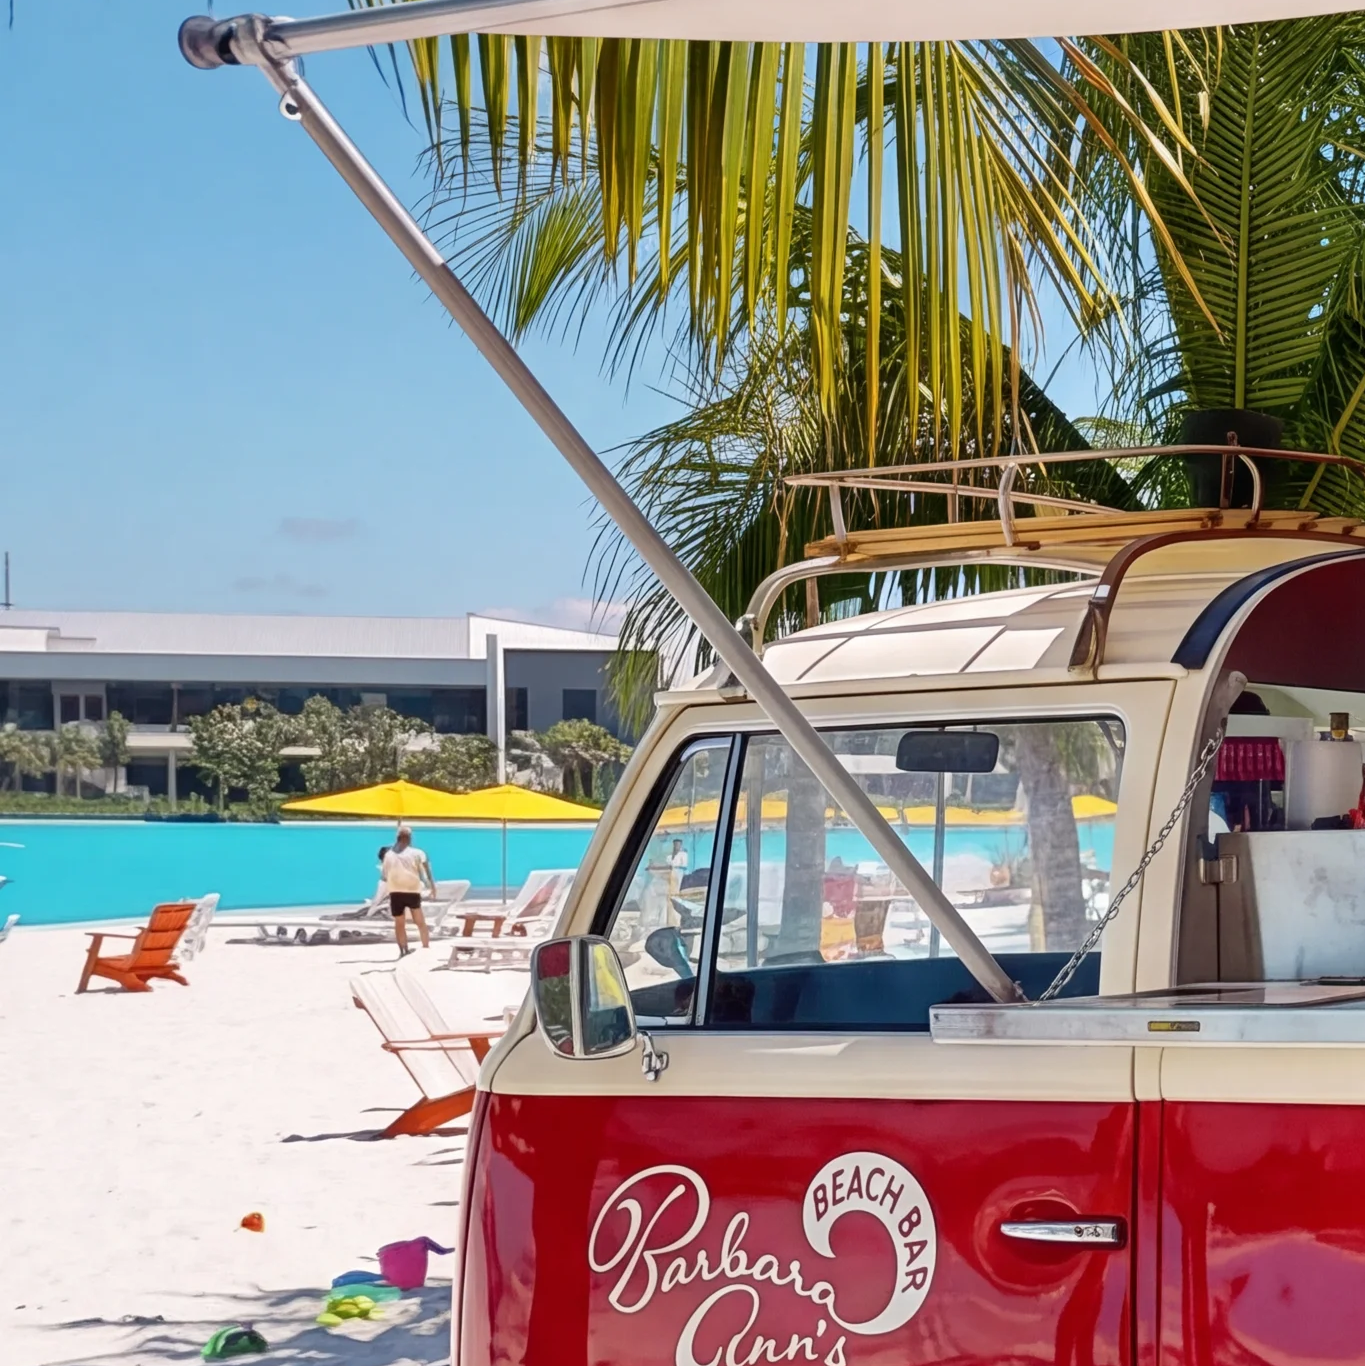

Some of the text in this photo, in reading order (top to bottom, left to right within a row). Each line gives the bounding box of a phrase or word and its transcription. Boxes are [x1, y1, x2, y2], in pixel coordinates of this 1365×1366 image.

[588, 1164, 855, 1314] Barbara
[812, 1165, 929, 1294] BEACH BAR
